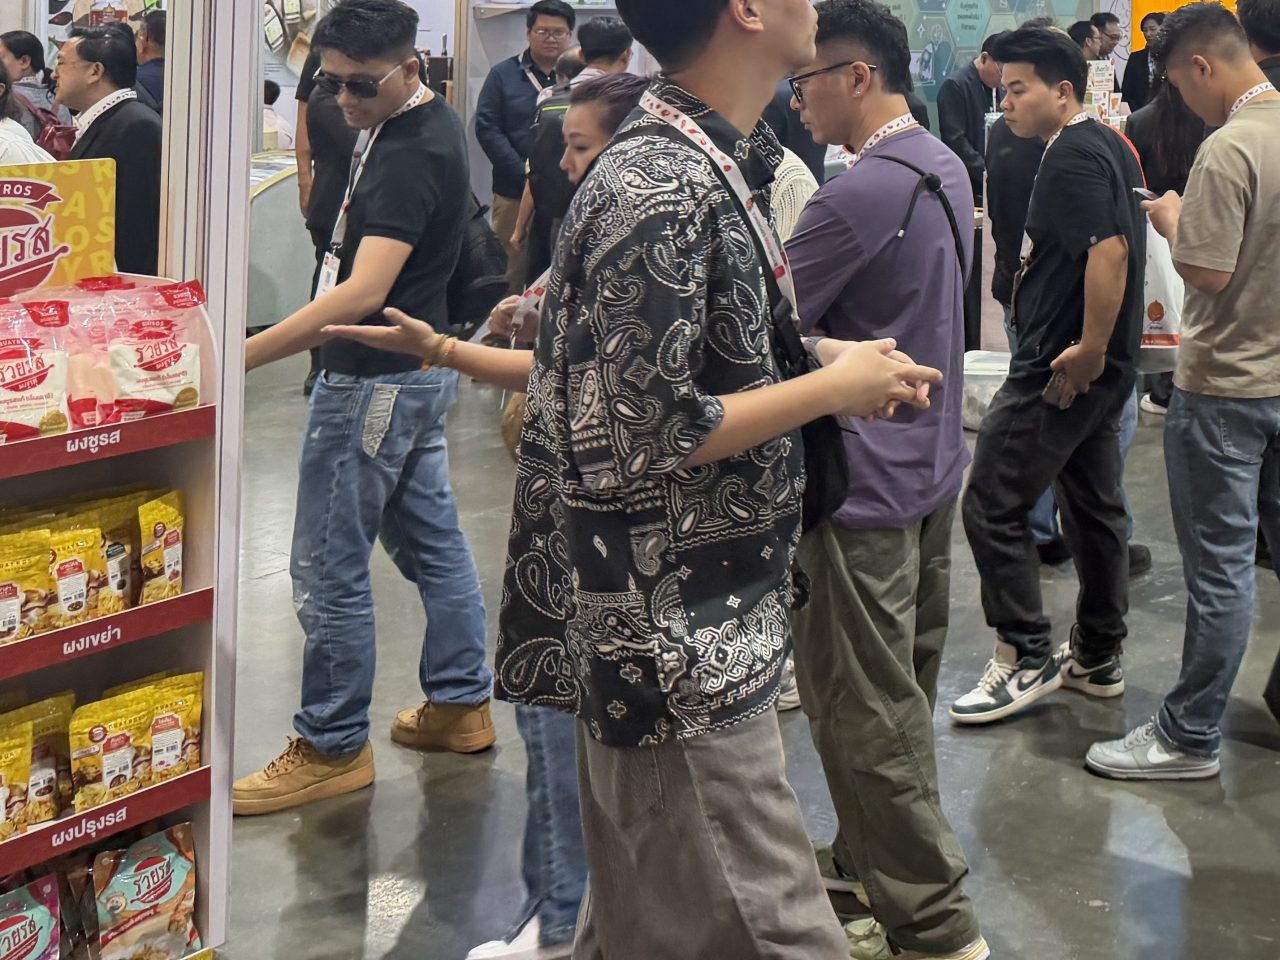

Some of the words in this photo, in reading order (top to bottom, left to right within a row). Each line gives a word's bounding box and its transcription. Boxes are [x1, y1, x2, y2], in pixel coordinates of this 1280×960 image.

[0, 183, 33, 197] ROS
[66, 429, 121, 454] ผงชูรส
[63, 625, 121, 655] ผงเขย่า
[51, 806, 128, 848] ผงปรุงรส
[0, 914, 37, 952] วยรส
